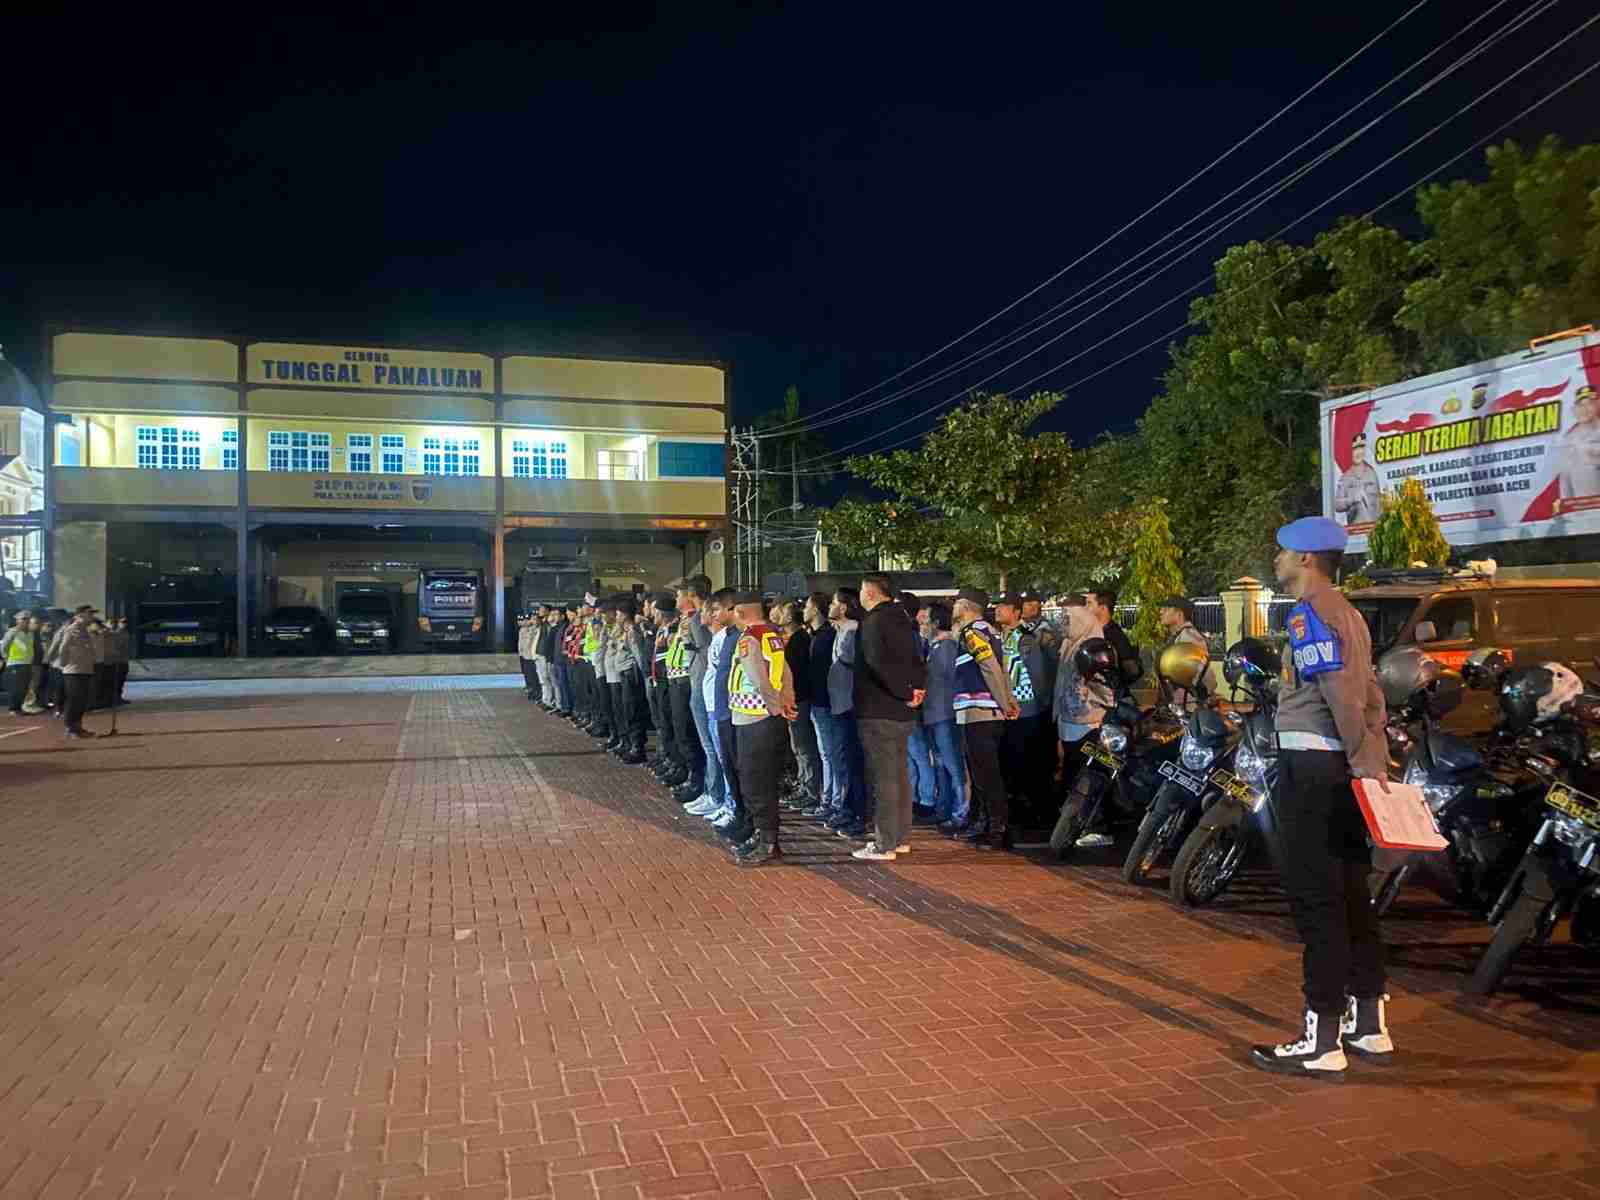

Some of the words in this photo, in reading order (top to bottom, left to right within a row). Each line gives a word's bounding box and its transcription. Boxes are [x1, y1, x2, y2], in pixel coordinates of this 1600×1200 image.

[262, 360, 361, 384] TUNGGAL
[374, 365, 482, 389] PANALUAN
[1376, 431, 1421, 463] SERAH
[1422, 418, 1481, 454] TERIMA
[1482, 402, 1560, 443] JABATAN
